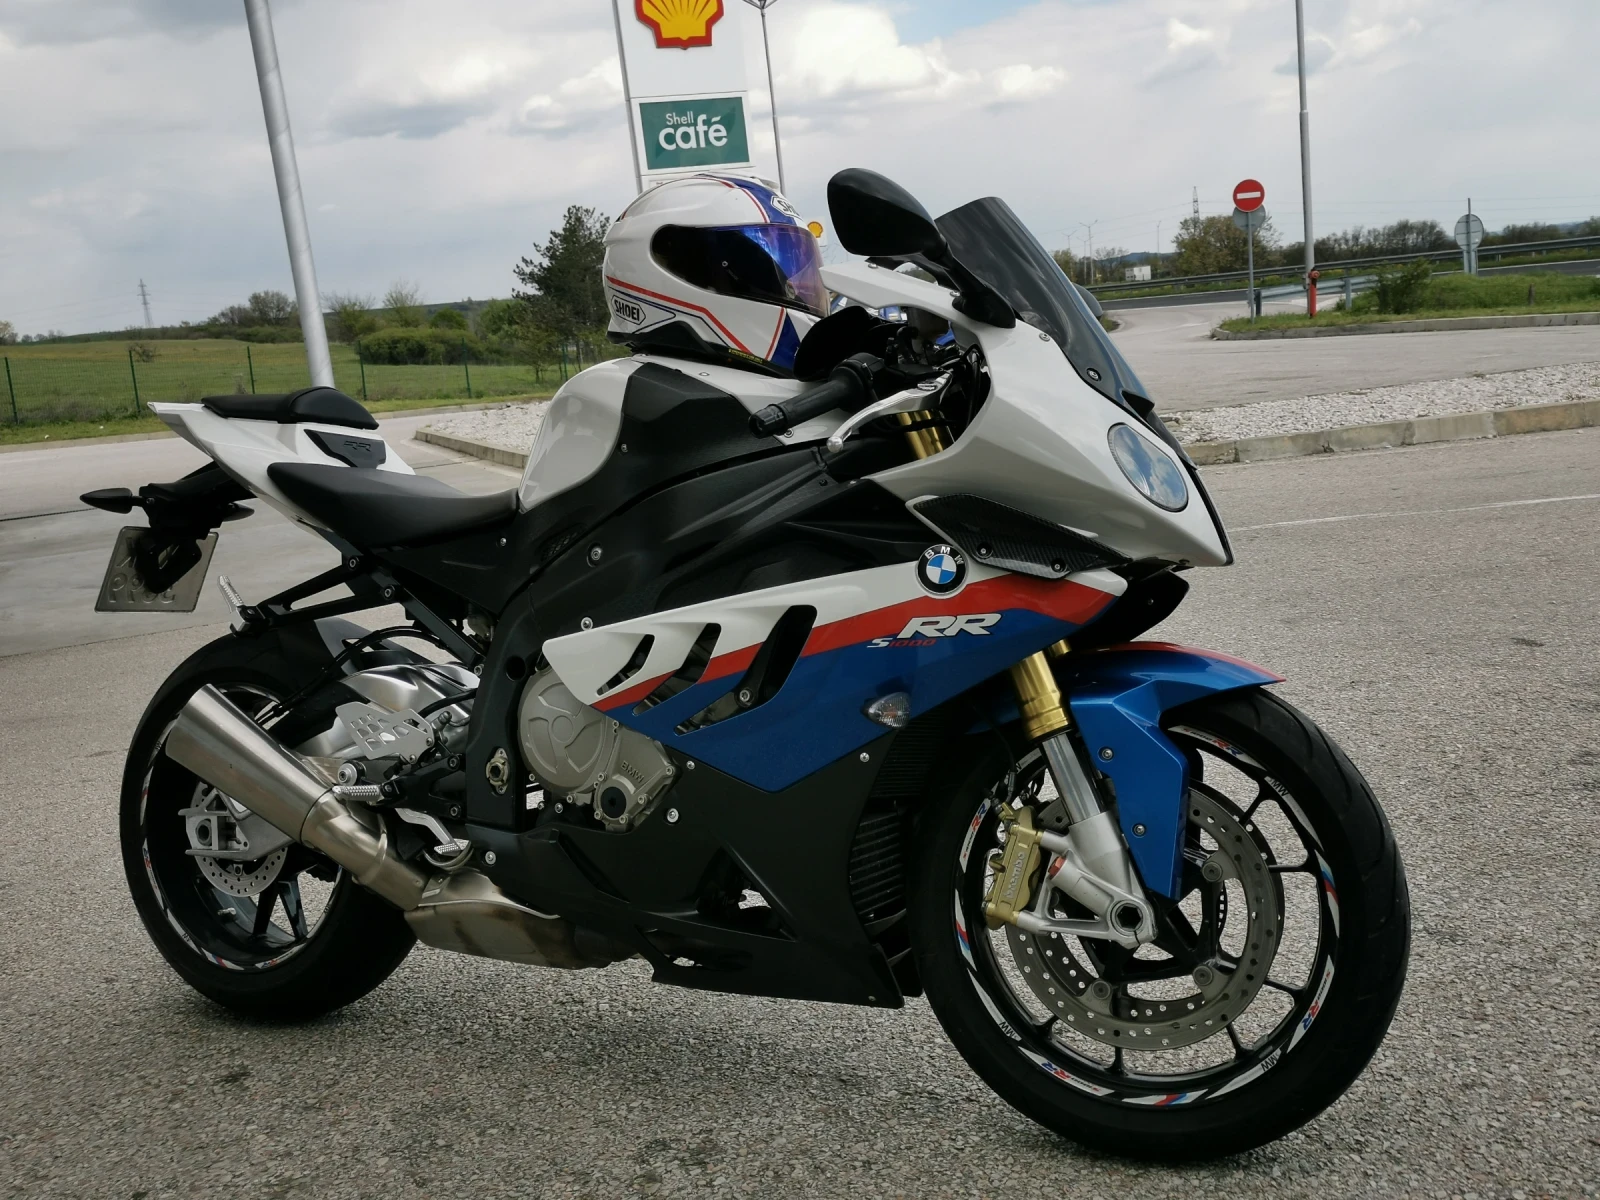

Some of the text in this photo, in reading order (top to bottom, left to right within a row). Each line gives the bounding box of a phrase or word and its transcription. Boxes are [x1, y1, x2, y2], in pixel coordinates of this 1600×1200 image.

[665, 111, 694, 125] Shell
[658, 114, 728, 150] café
[614, 299, 640, 321] SHOEI
[924, 545, 965, 565] BMW
[896, 613, 1002, 640] RR
[619, 760, 645, 784] BMW
[1005, 851, 1027, 899] brembo
